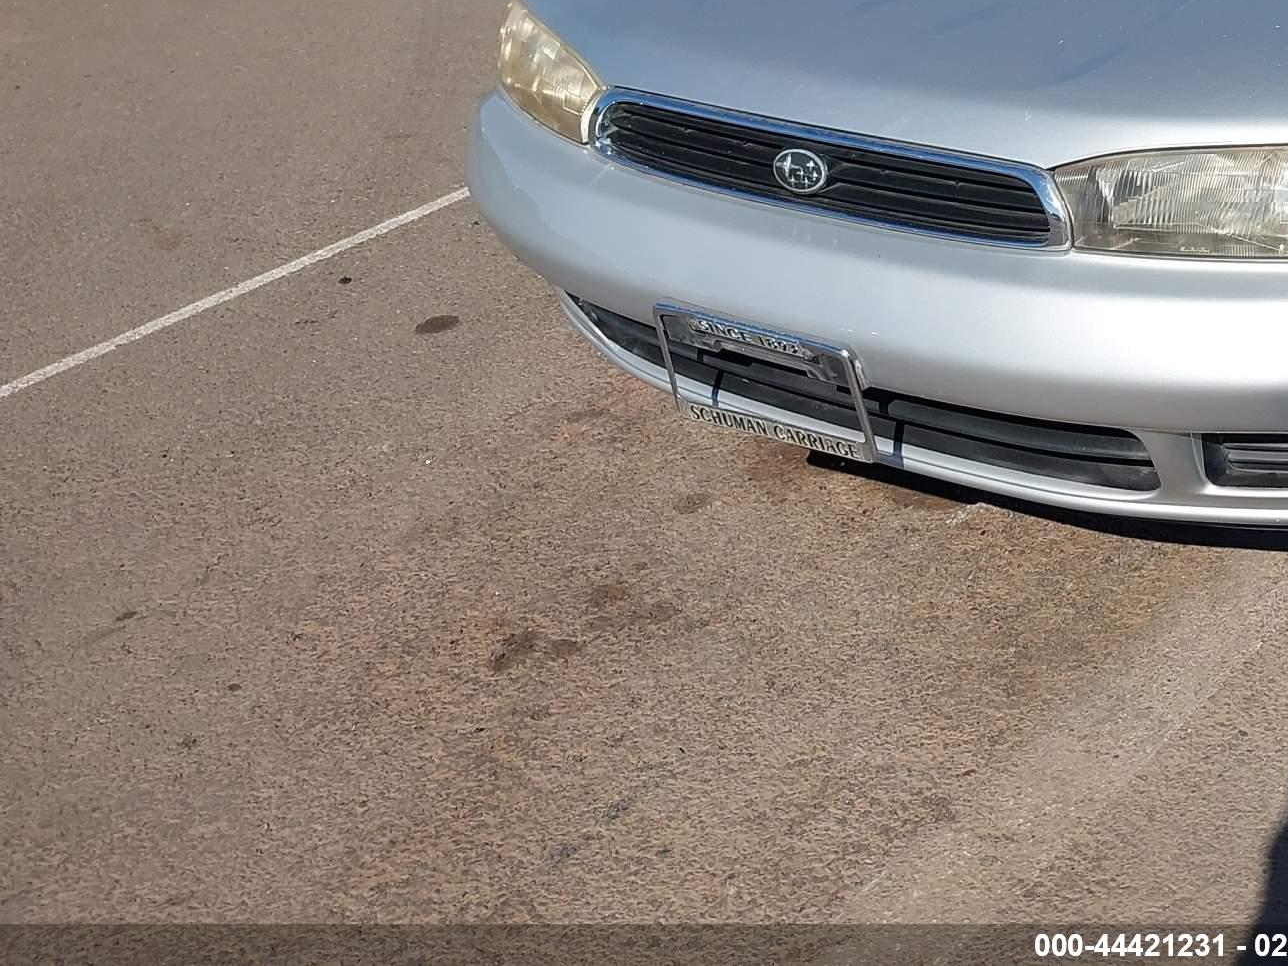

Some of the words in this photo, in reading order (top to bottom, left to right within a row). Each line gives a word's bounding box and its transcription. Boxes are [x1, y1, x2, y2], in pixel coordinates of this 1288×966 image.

[699, 319, 753, 343] SINCE
[690, 405, 769, 435] SCHUMAN
[773, 425, 861, 458] CARRIAGE
